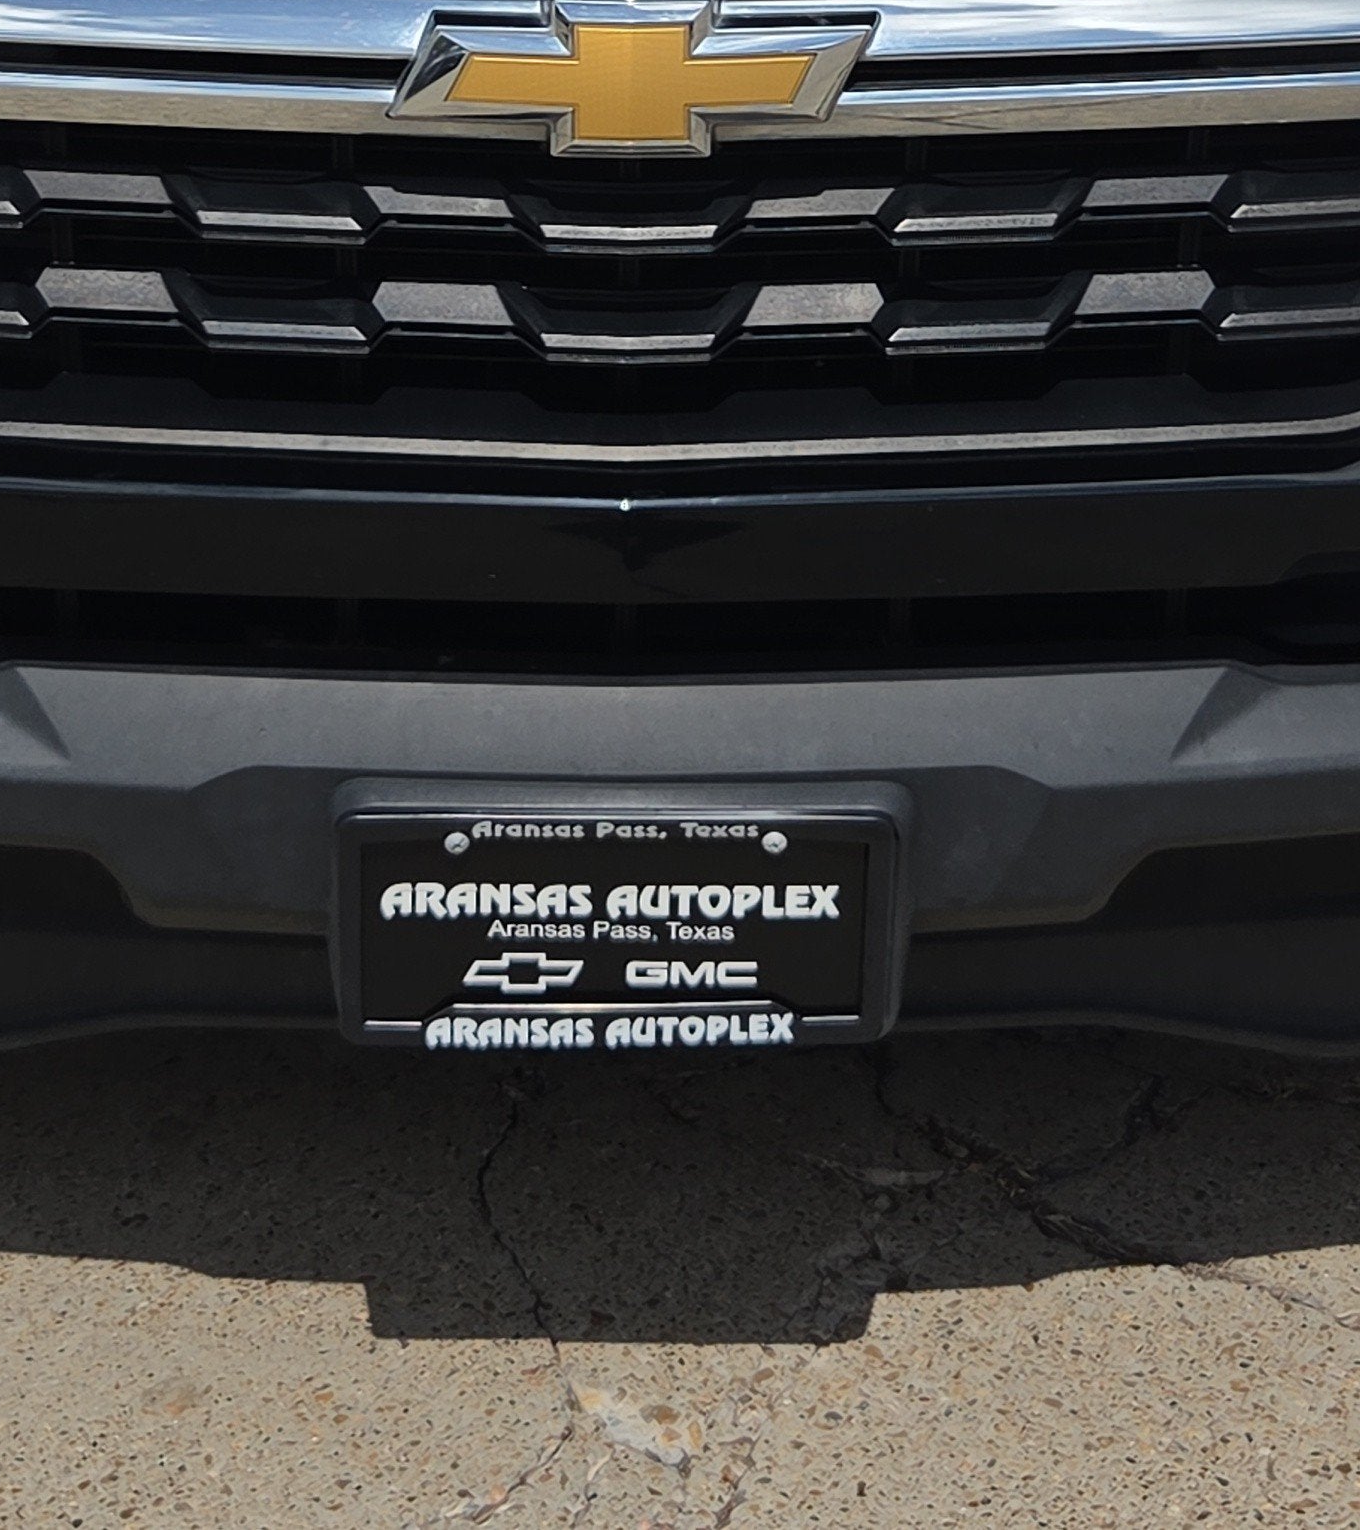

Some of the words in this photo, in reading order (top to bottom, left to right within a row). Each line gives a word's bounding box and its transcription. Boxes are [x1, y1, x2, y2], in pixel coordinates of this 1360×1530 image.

[471, 820, 586, 840] Aransas
[596, 821, 668, 840] Pass,
[680, 821, 760, 839] Texas
[379, 881, 594, 921] ARANSAS
[605, 883, 840, 920] AUTOPLEX
[486, 920, 586, 941] Aransas
[592, 920, 659, 942] Pass,
[665, 920, 736, 941] Texas
[624, 960, 759, 988] GMC
[424, 1015, 596, 1050] ARANSAS
[604, 1012, 794, 1050] AUTOPLEX
